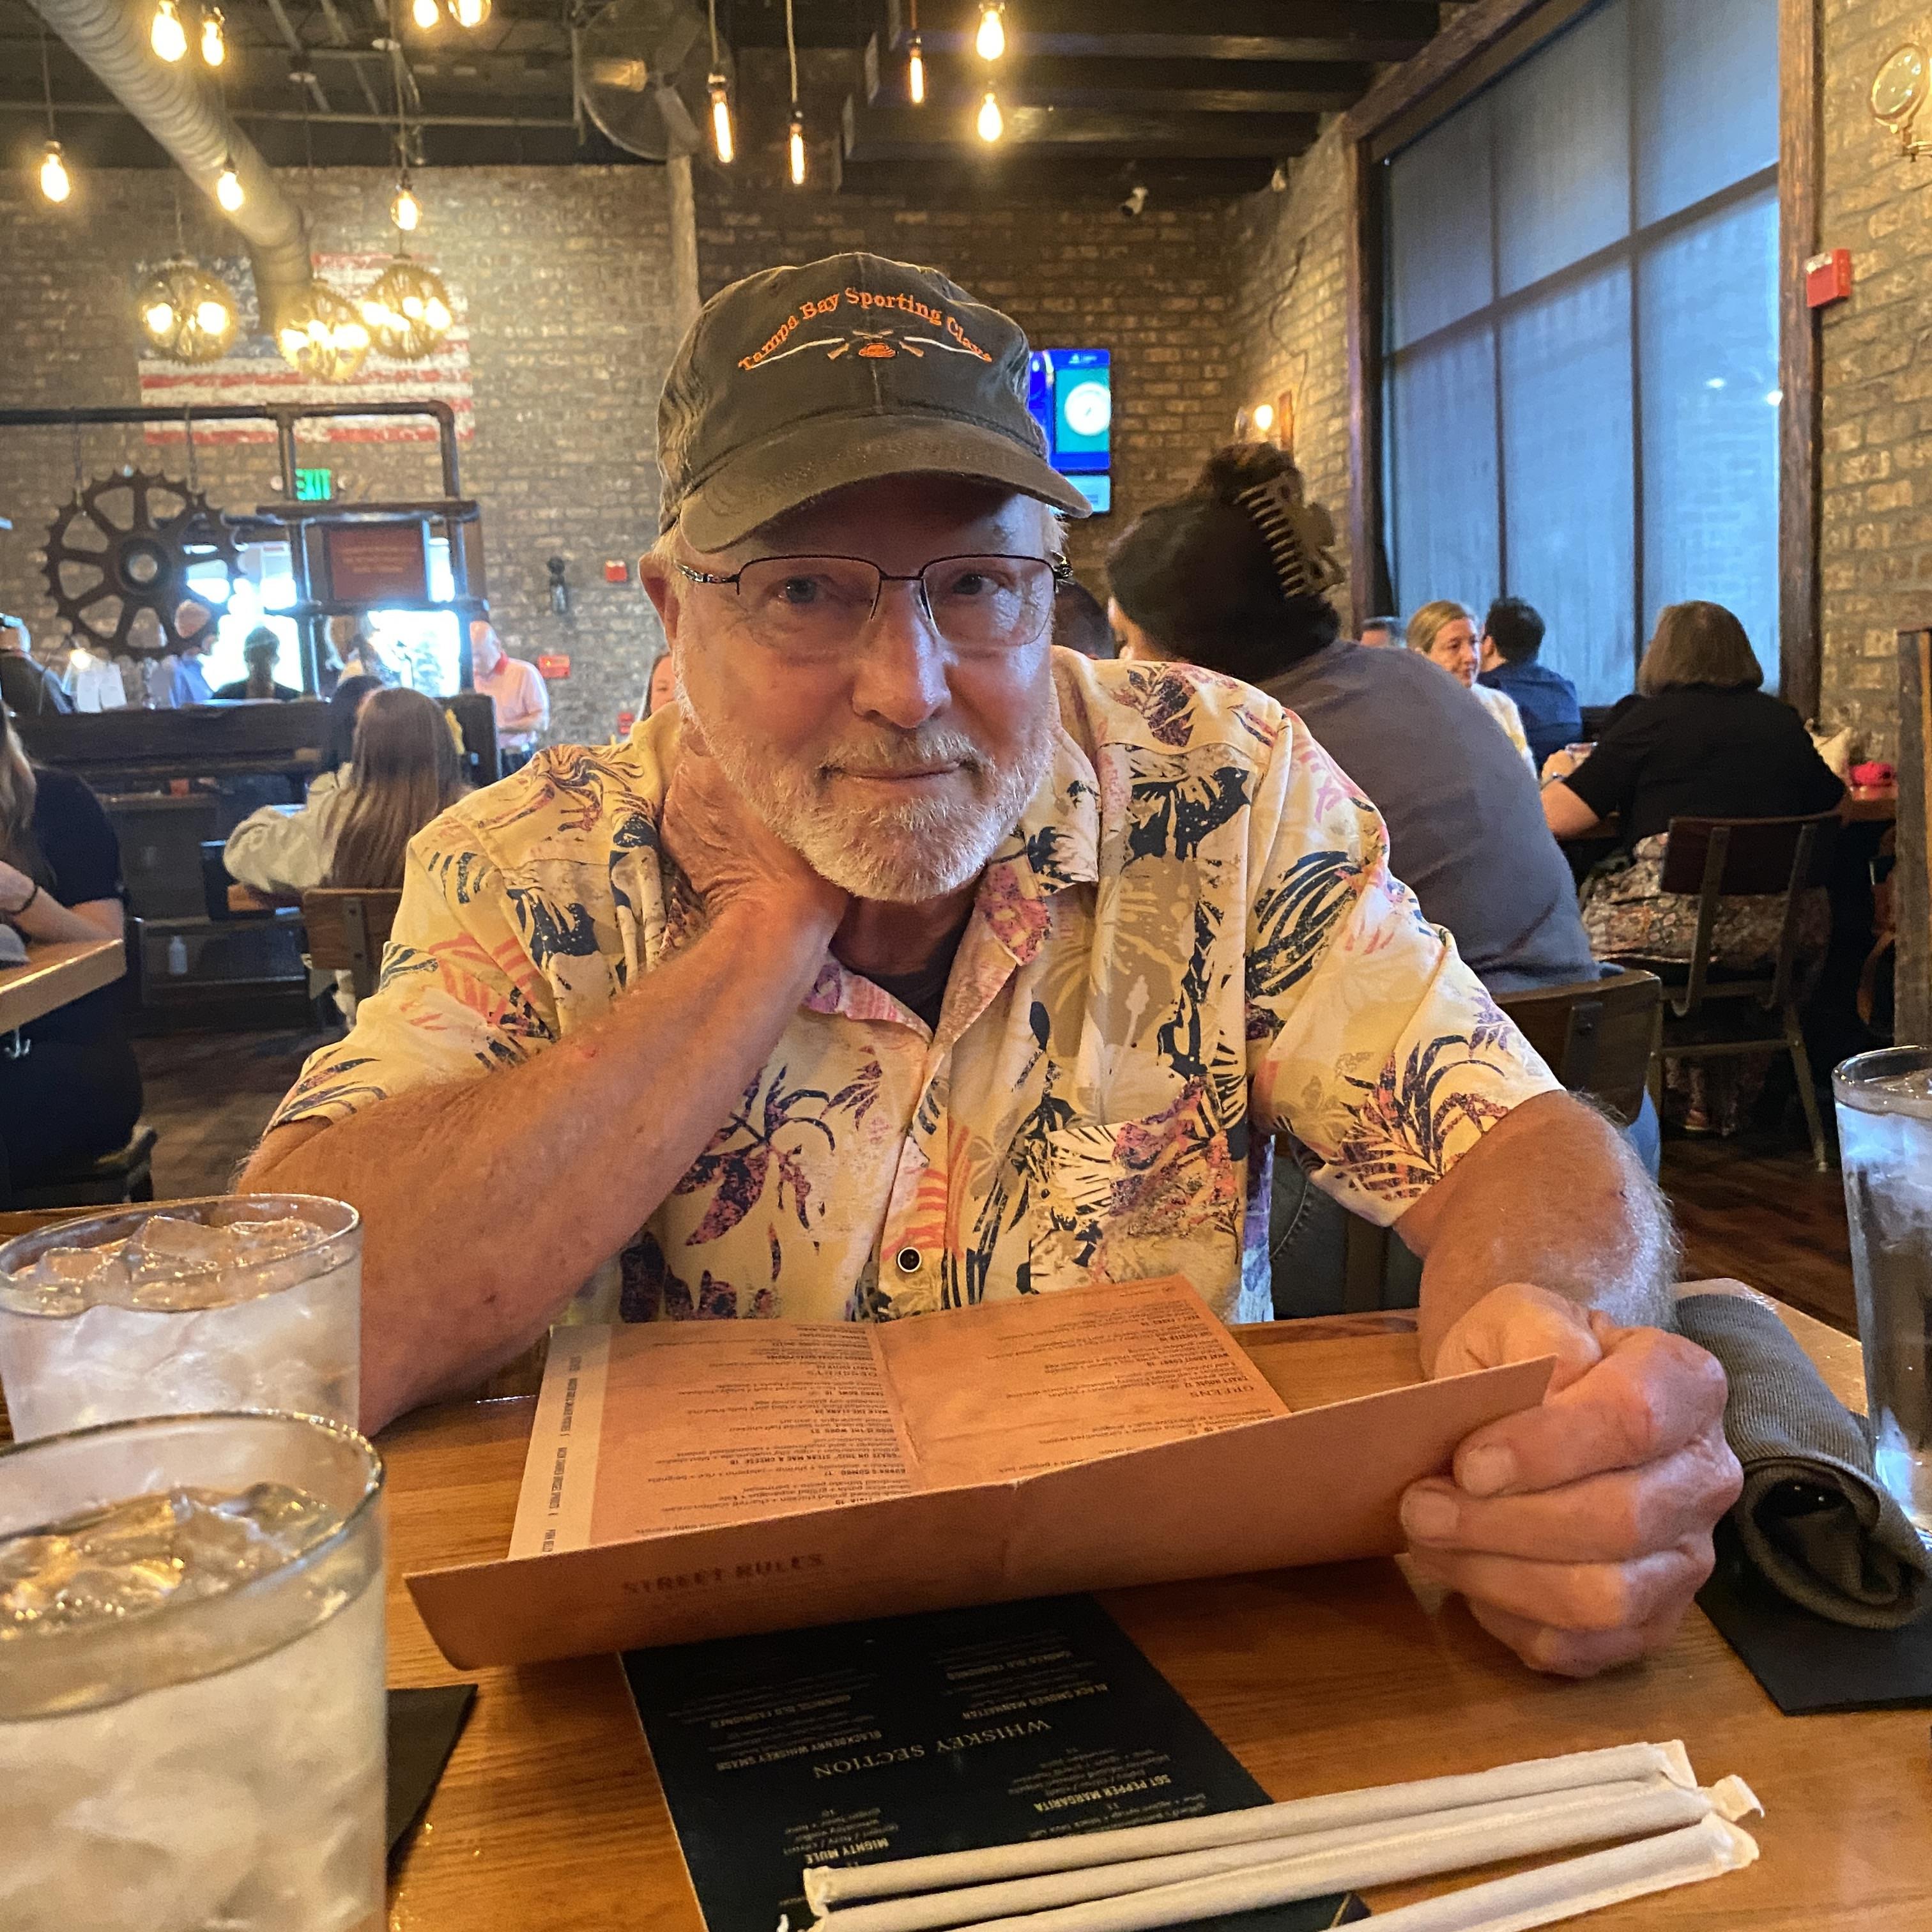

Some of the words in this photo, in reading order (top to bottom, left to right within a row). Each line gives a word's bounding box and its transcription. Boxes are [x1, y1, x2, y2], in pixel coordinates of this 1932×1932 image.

[738, 315, 799, 371] Tampa
[799, 293, 839, 320] Bay
[845, 287, 942, 326] Sporting
[947, 316, 993, 363] Clays
[295, 468, 332, 501] EXIT
[962, 1699, 1027, 1721] MANHATTAN
[935, 1717, 1052, 1753] WHISKEY
[715, 1755, 756, 1771] SMASH
[759, 1744, 808, 1762] WHISKEY
[810, 1738, 924, 1778] SECTION
[1103, 1778, 1147, 1797] PEPPER
[1149, 1773, 1170, 1786] SGT
[1033, 1788, 1101, 1813] MARGARITA
[843, 1836, 889, 1855] MIGHTY
[804, 1848, 838, 1864] MULE
